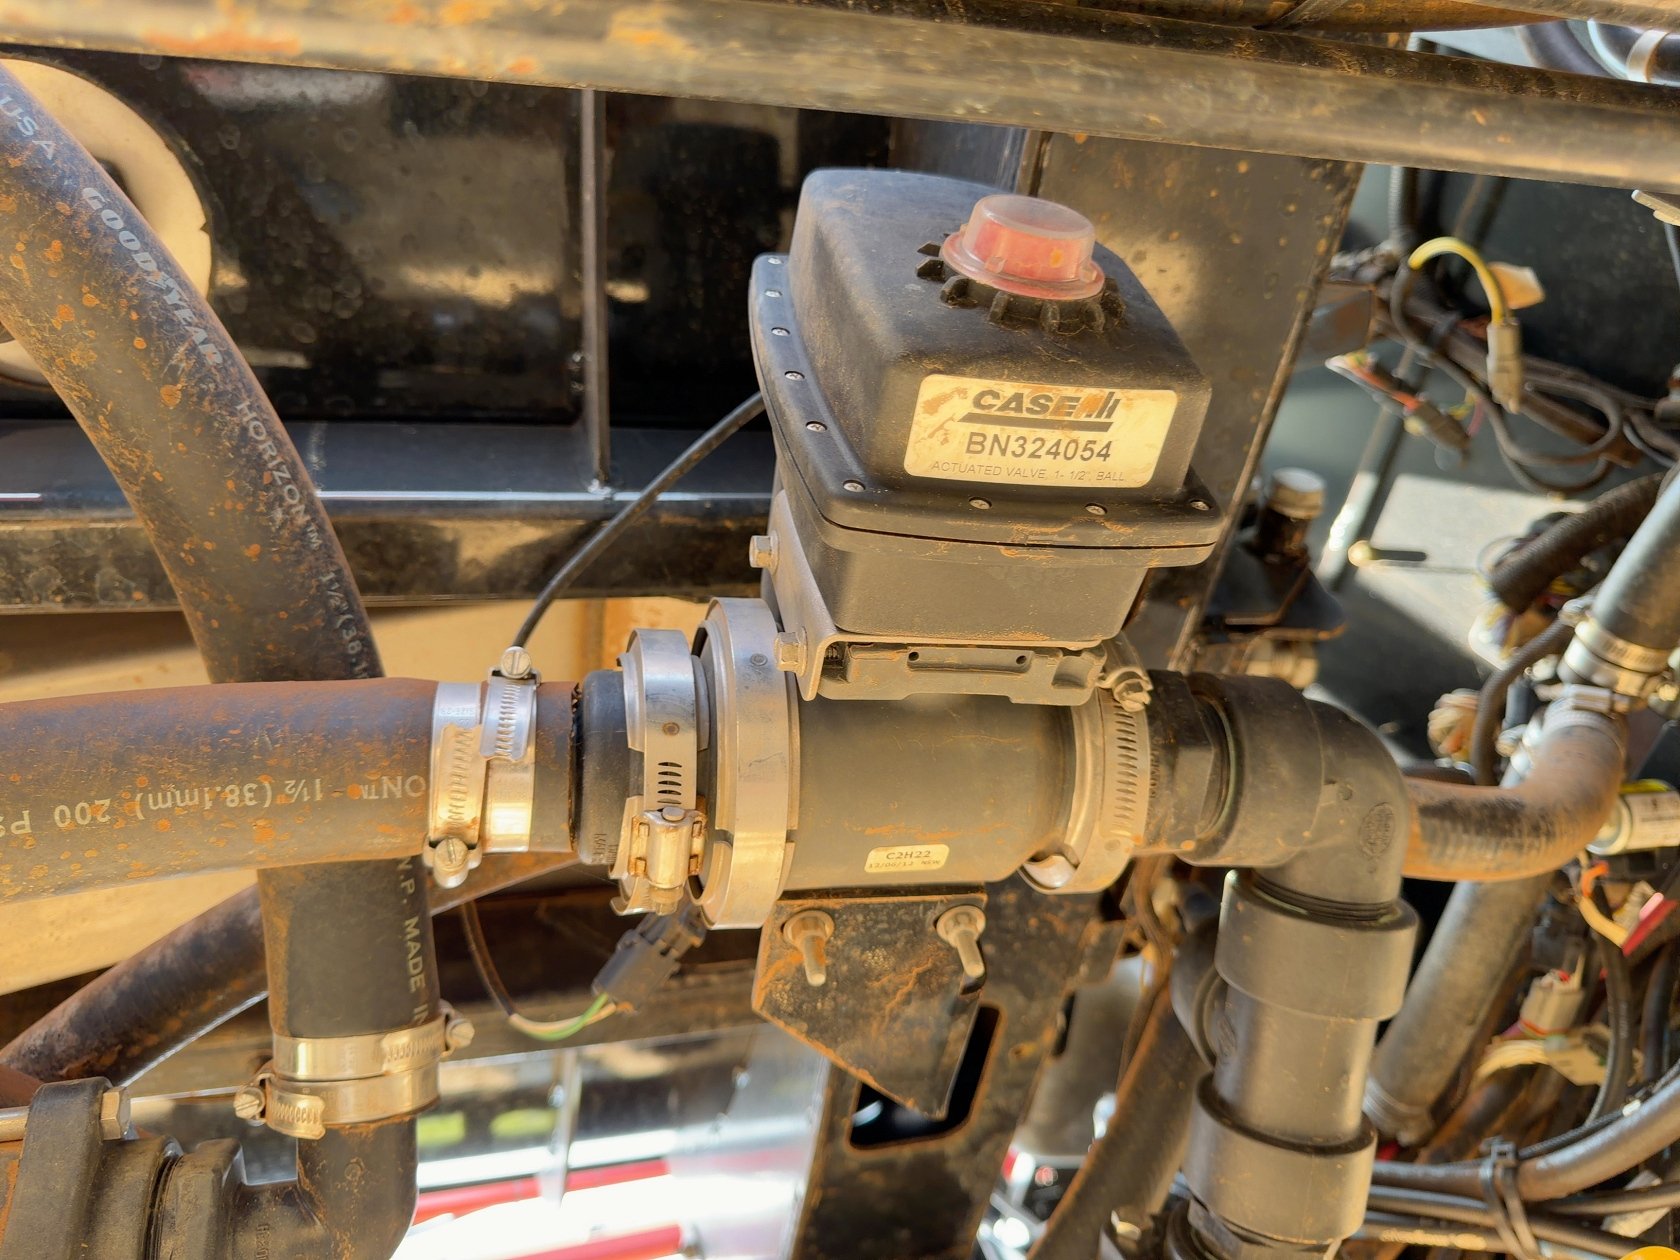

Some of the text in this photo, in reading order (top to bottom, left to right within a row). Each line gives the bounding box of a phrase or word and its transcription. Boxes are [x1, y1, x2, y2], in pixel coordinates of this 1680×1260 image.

[83, 187, 222, 367] GOODYEAR
[965, 431, 1113, 462] BN324054
[931, 460, 1002, 477] ACTUATED
[1096, 471, 1125, 482] BALL
[54, 799, 112, 828] 200
[886, 850, 931, 860] C2H22
[404, 916, 425, 993] MADE
